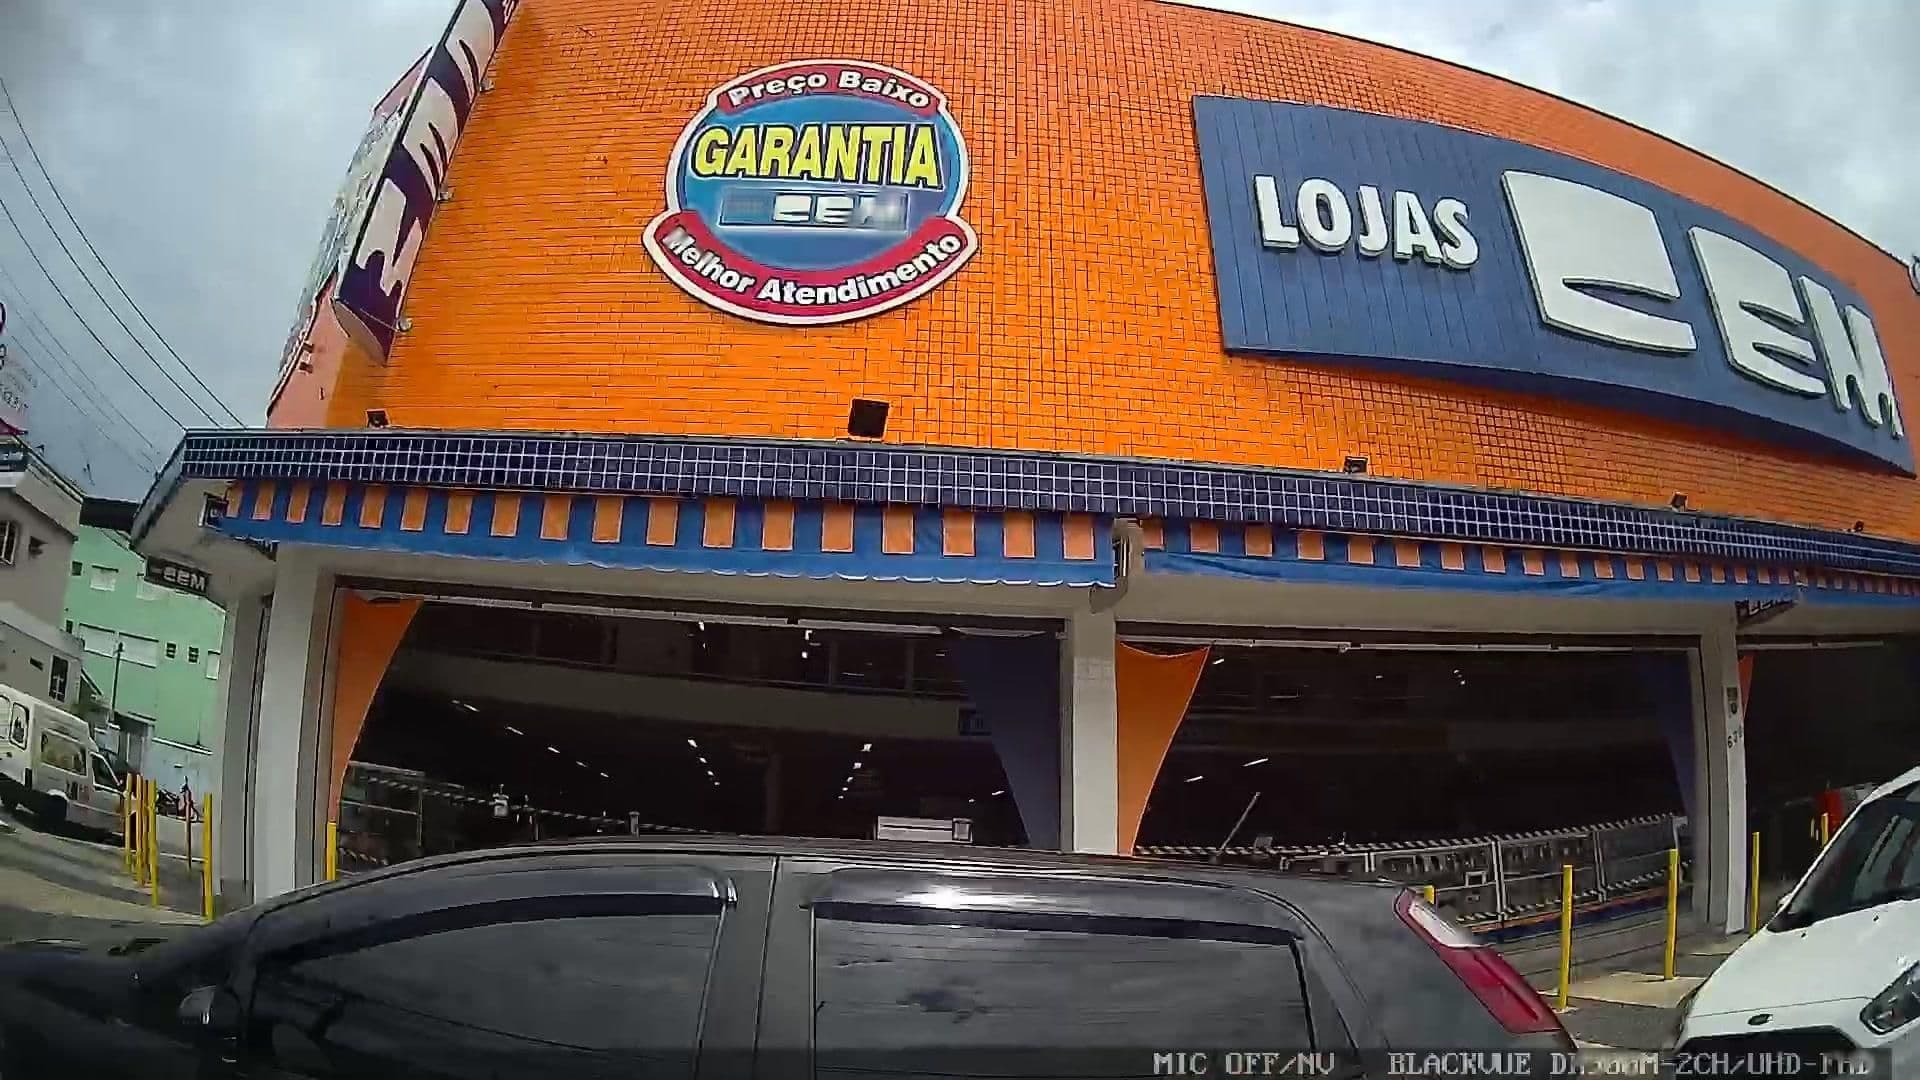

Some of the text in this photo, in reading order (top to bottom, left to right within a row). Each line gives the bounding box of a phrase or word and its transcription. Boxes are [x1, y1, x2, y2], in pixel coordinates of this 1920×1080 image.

[728, 71, 930, 108] Preço Baixo
[693, 125, 941, 189] GARANTIA
[773, 194, 905, 224] CE
[757, 234, 962, 305] Atendimento
[1253, 169, 1905, 439] LOJAS CEM
